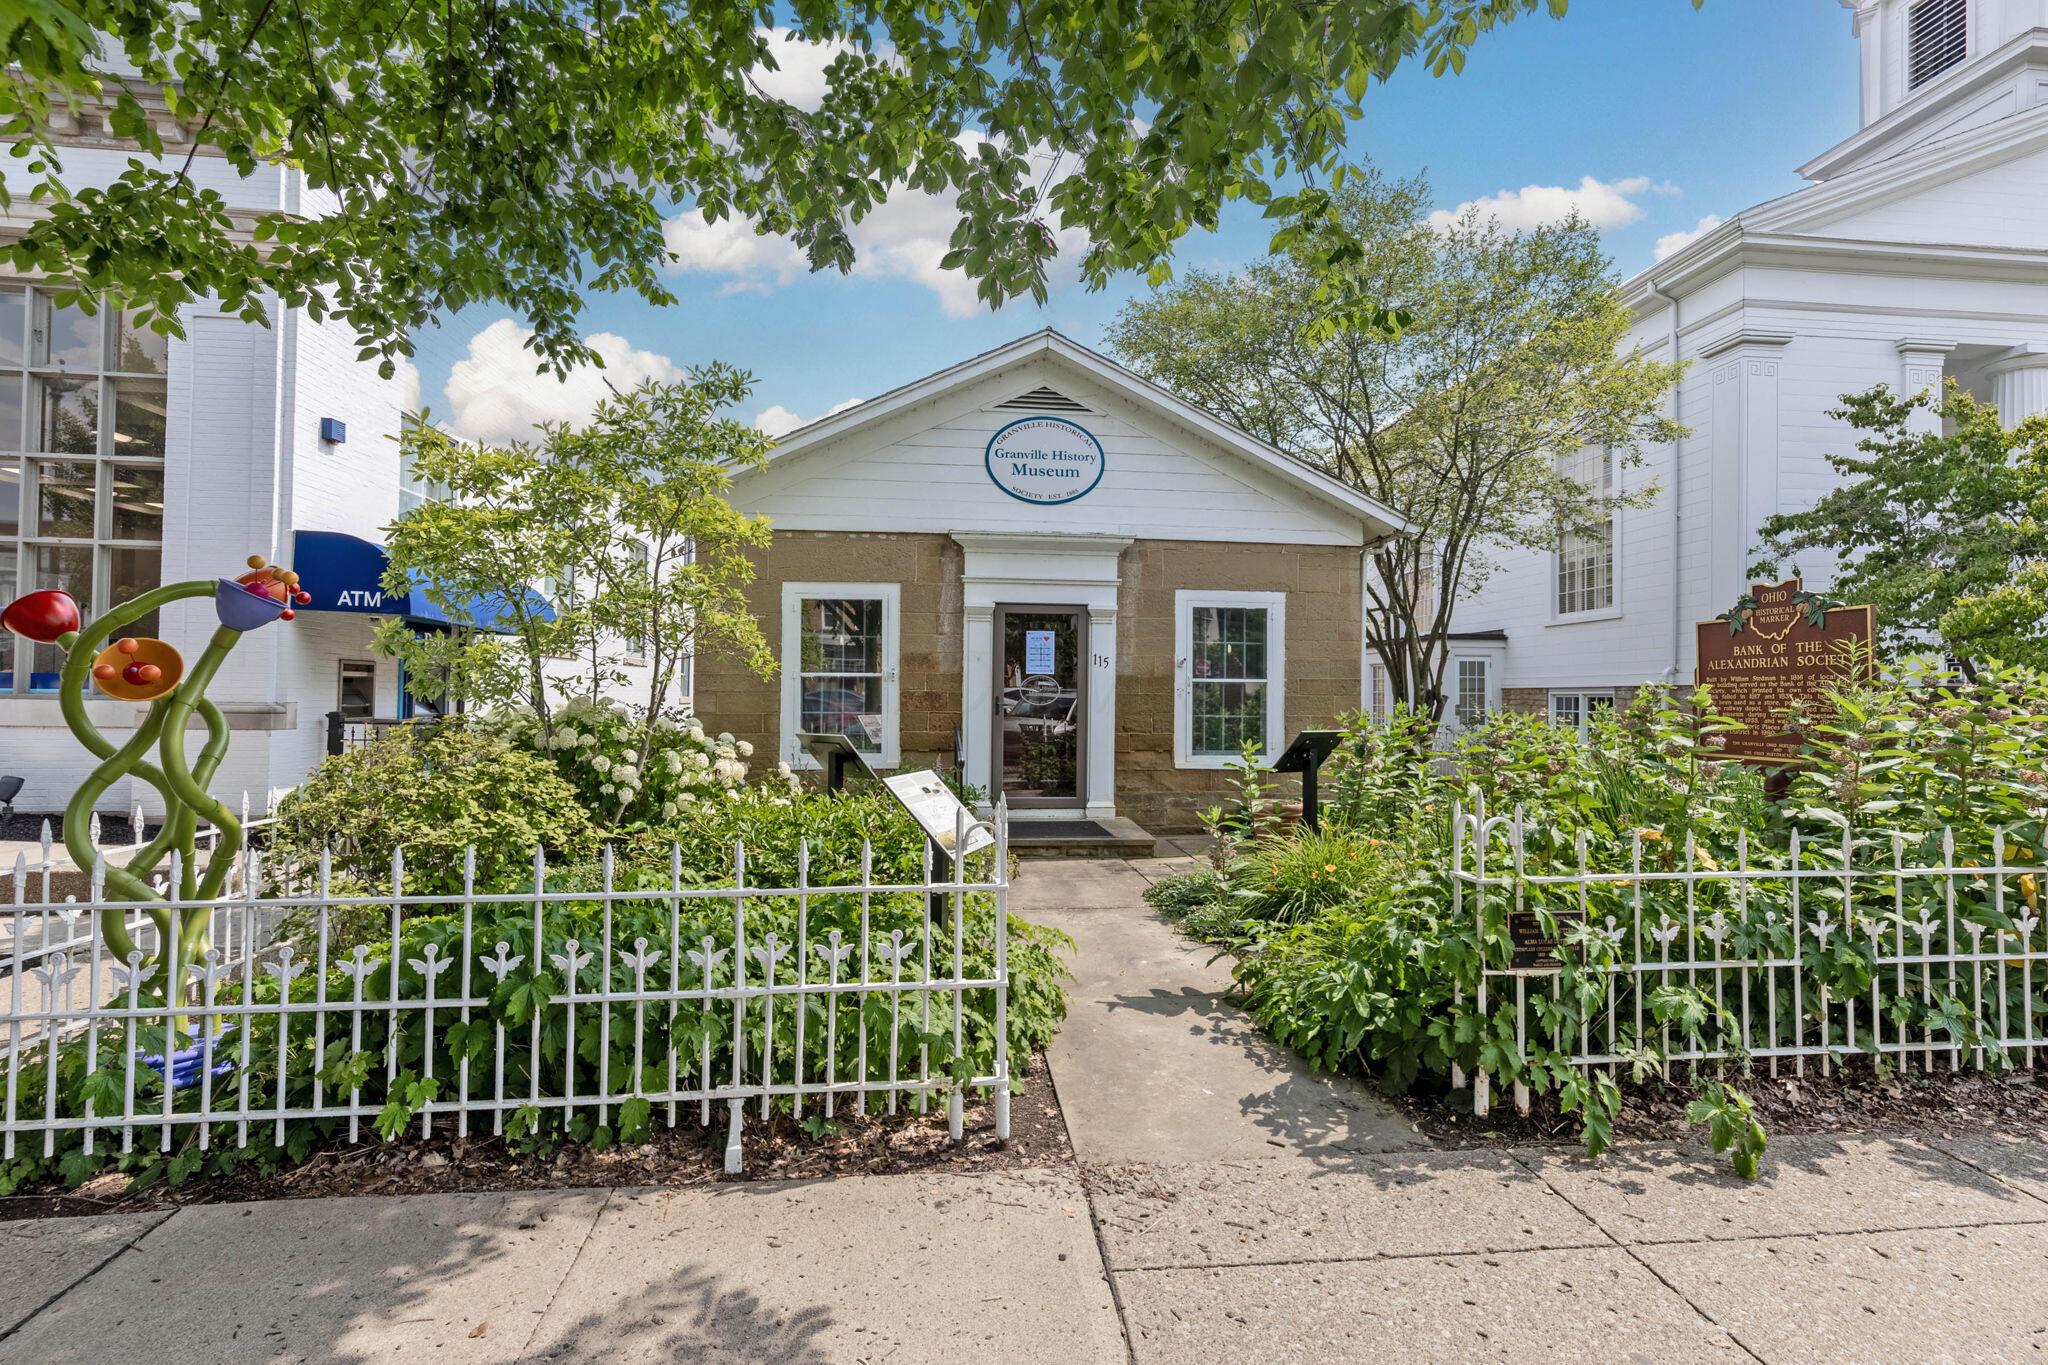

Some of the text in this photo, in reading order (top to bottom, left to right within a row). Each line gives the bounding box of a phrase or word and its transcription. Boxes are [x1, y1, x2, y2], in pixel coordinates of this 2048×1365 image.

[996, 422, 1094, 448] GRANVILLE HISTORICAL
[994, 448, 1096, 464] Granville History
[1012, 463, 1080, 478] Museum
[1012, 486, 1042, 499] SOCIETY
[337, 590, 381, 608] ATM
[1761, 590, 1787, 602] OHIO
[1755, 606, 1794, 616] HISTORICAL
[1760, 615, 1790, 624] MARKER
[1734, 641, 1822, 656] BANK OF THE
[1093, 653, 1109, 669] 115
[1708, 654, 1853, 670] ALEXANDRIAN SOCIET
